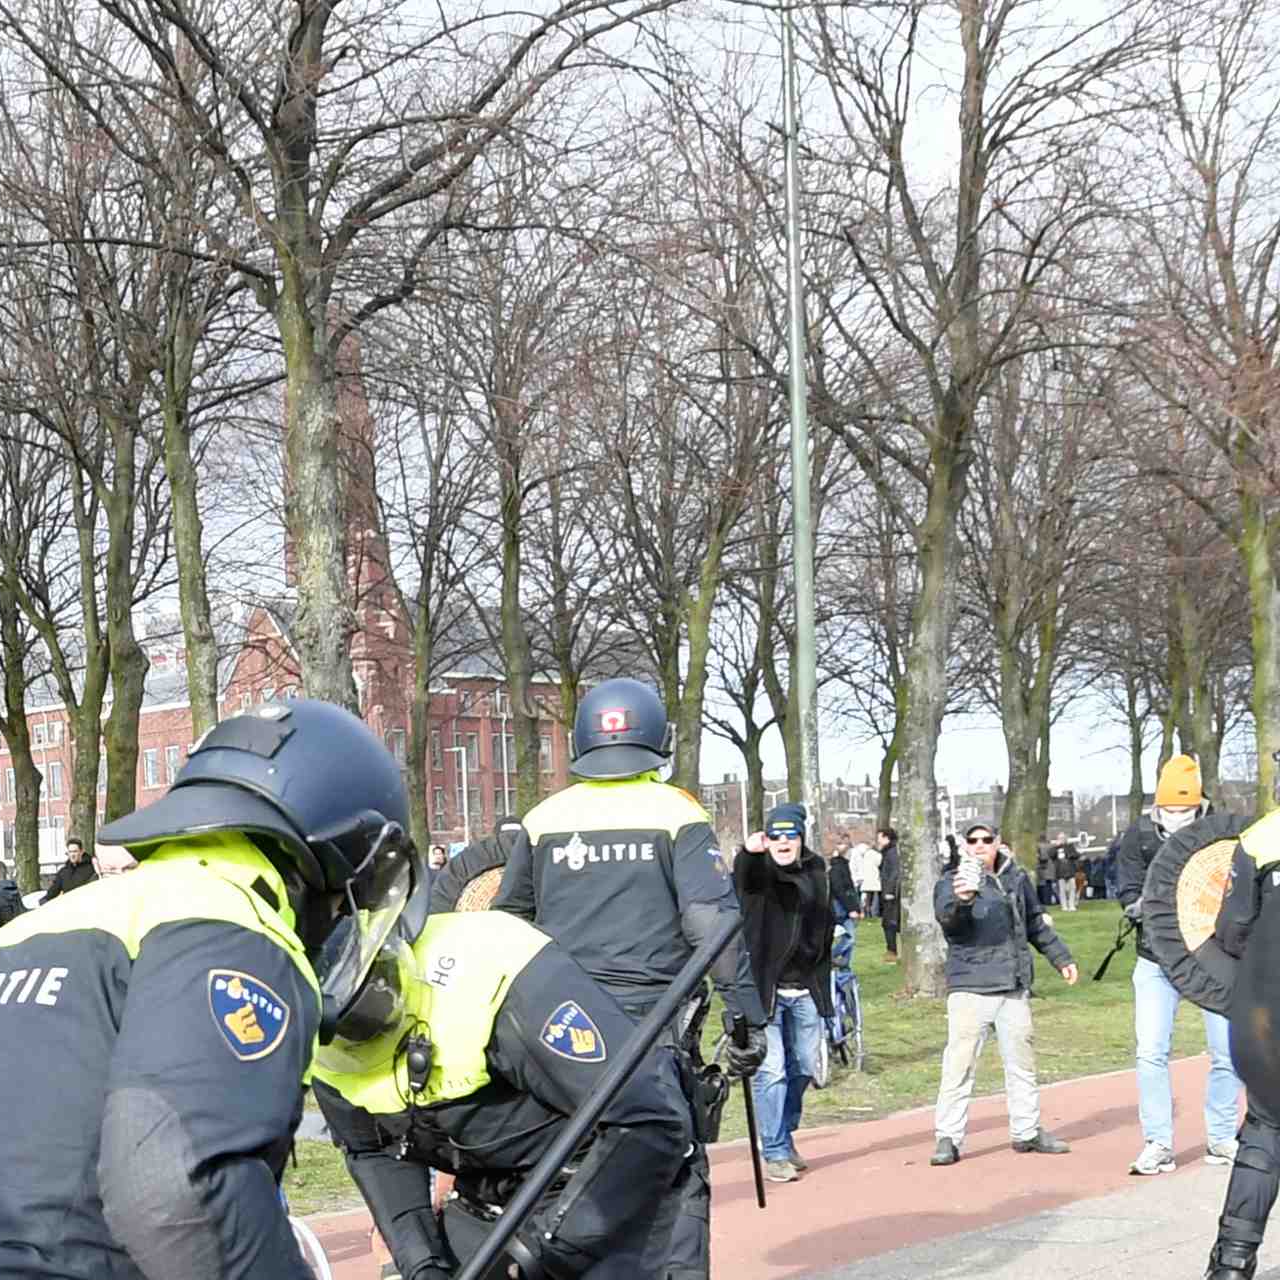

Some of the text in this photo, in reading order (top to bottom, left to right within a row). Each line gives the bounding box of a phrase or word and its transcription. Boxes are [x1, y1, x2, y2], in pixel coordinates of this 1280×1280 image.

[552, 832, 655, 870] POLITIE
[431, 956, 456, 987] HG
[214, 978, 283, 1021] POLITIE
